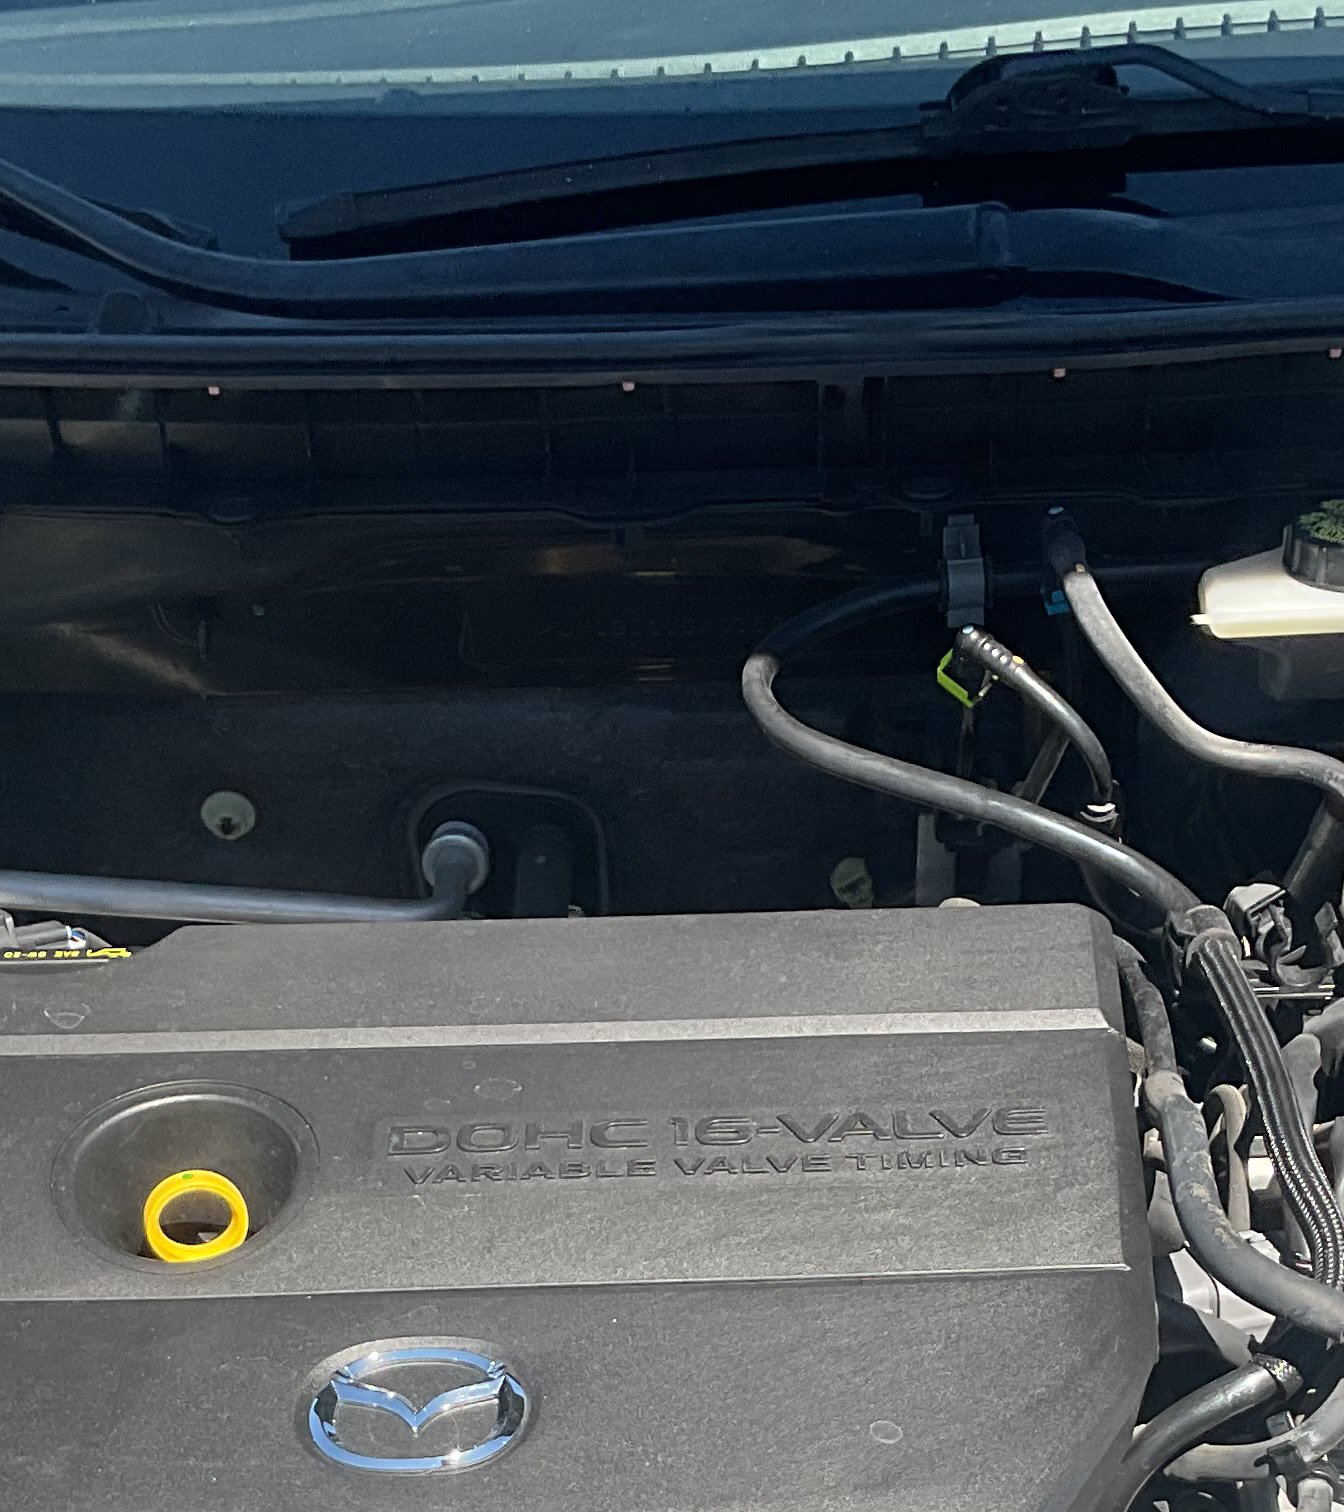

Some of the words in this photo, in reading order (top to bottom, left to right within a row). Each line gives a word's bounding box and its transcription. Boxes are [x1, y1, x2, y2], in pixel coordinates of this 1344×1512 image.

[54, 950, 80, 958] SAE
[387, 1116, 648, 1156] DOHC
[668, 1106, 1049, 1147] 16-VALVE
[404, 1158, 656, 1185] VARIABLE
[673, 1153, 832, 1176] VALVE
[846, 1146, 1028, 1171] TIMING
